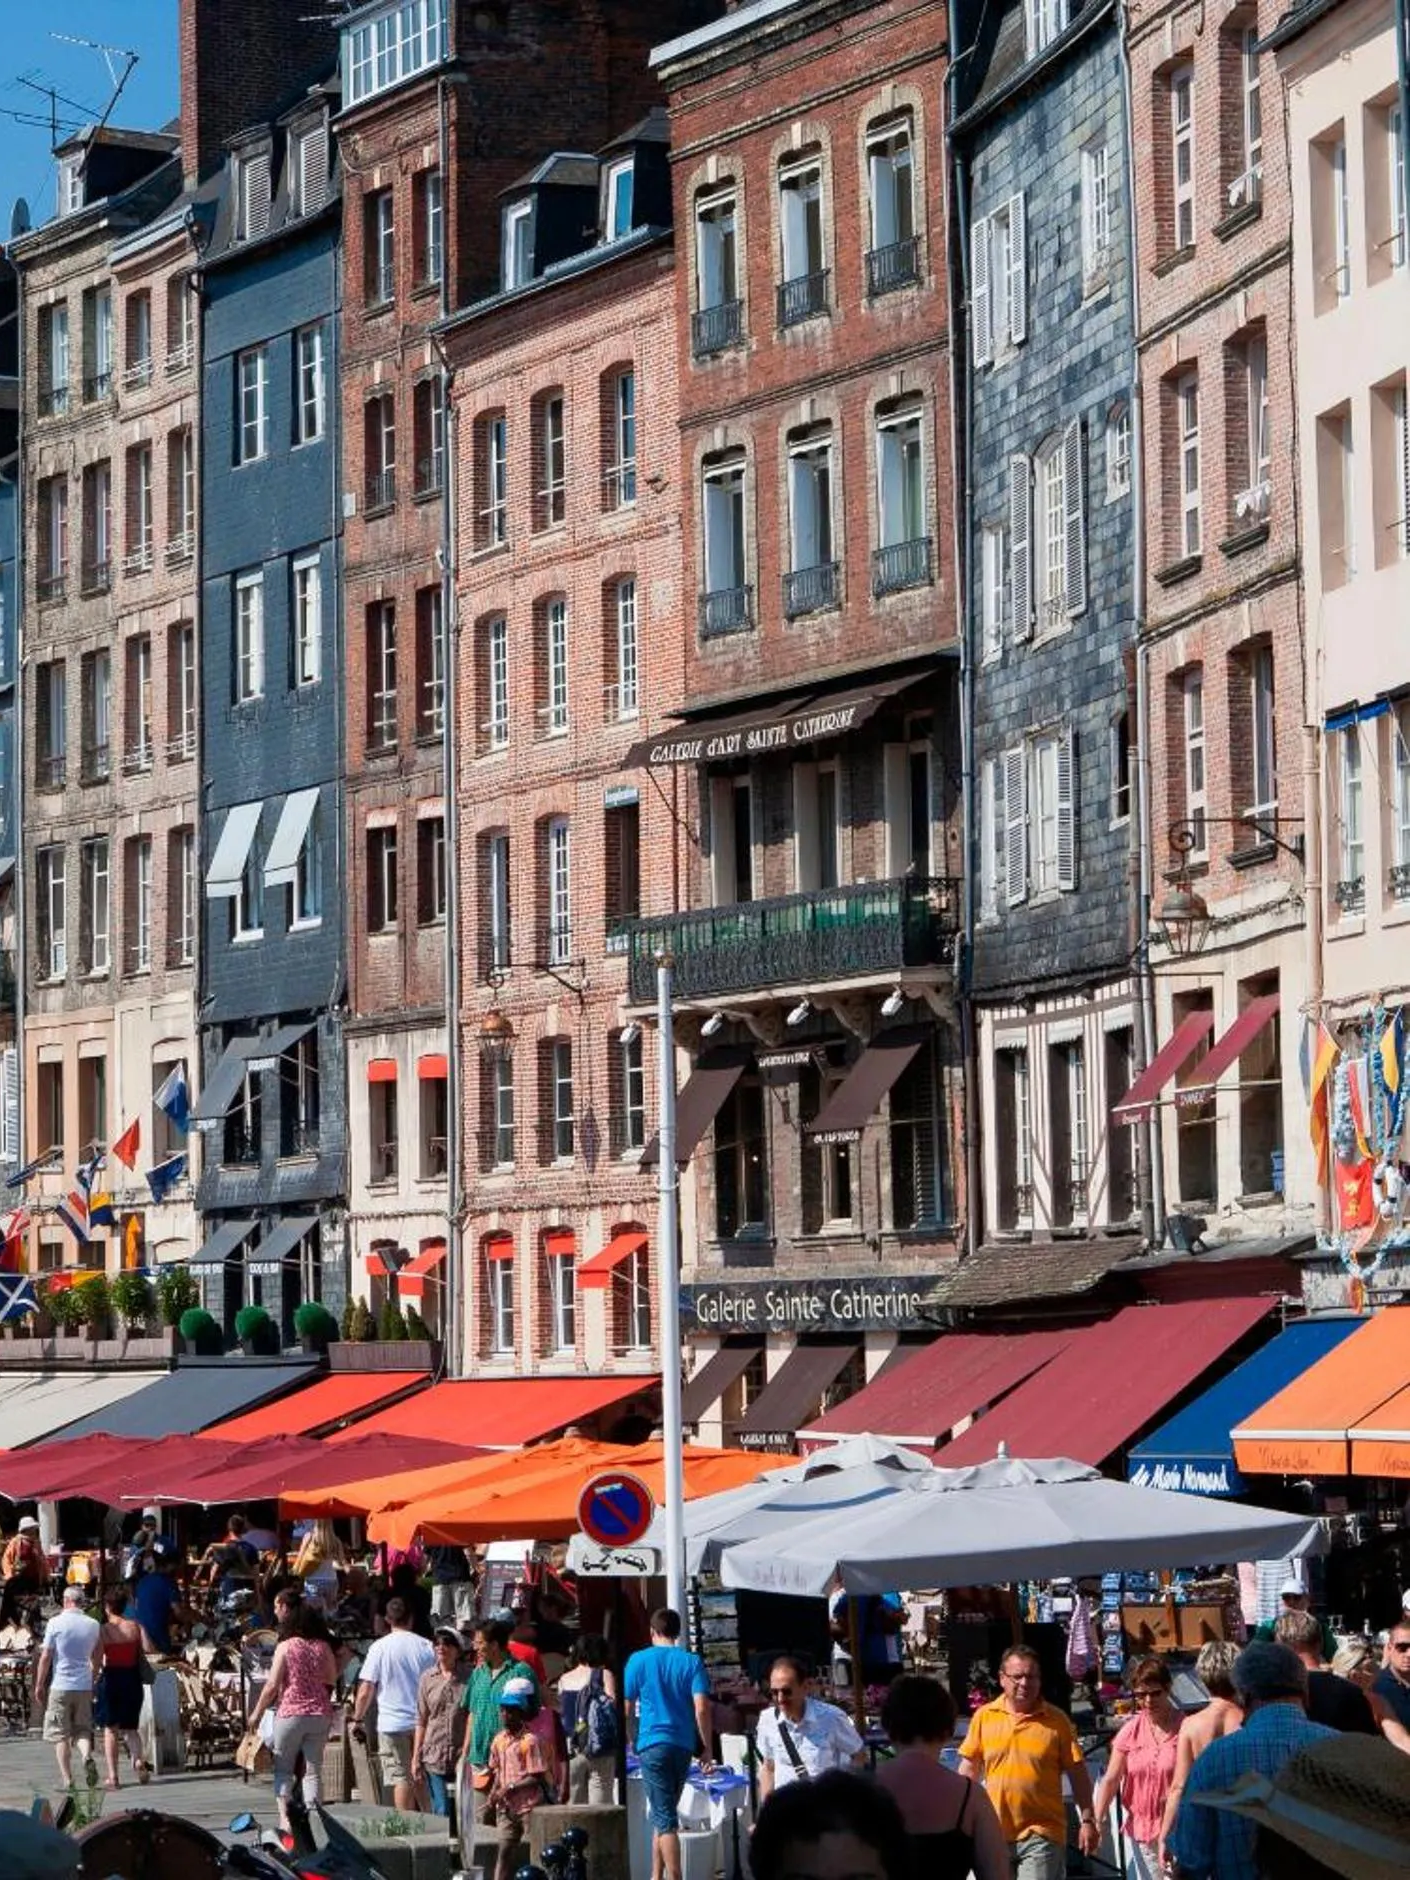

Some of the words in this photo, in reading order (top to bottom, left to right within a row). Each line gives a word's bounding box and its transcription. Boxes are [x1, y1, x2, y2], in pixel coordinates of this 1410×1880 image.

[650, 740, 702, 762] GALERIE
[747, 724, 787, 749] SAINTE
[793, 706, 856, 740] CATHERINE
[696, 1291, 757, 1323] Galerie
[765, 1290, 821, 1321] Sainte
[830, 1285, 920, 1319] Catherine
